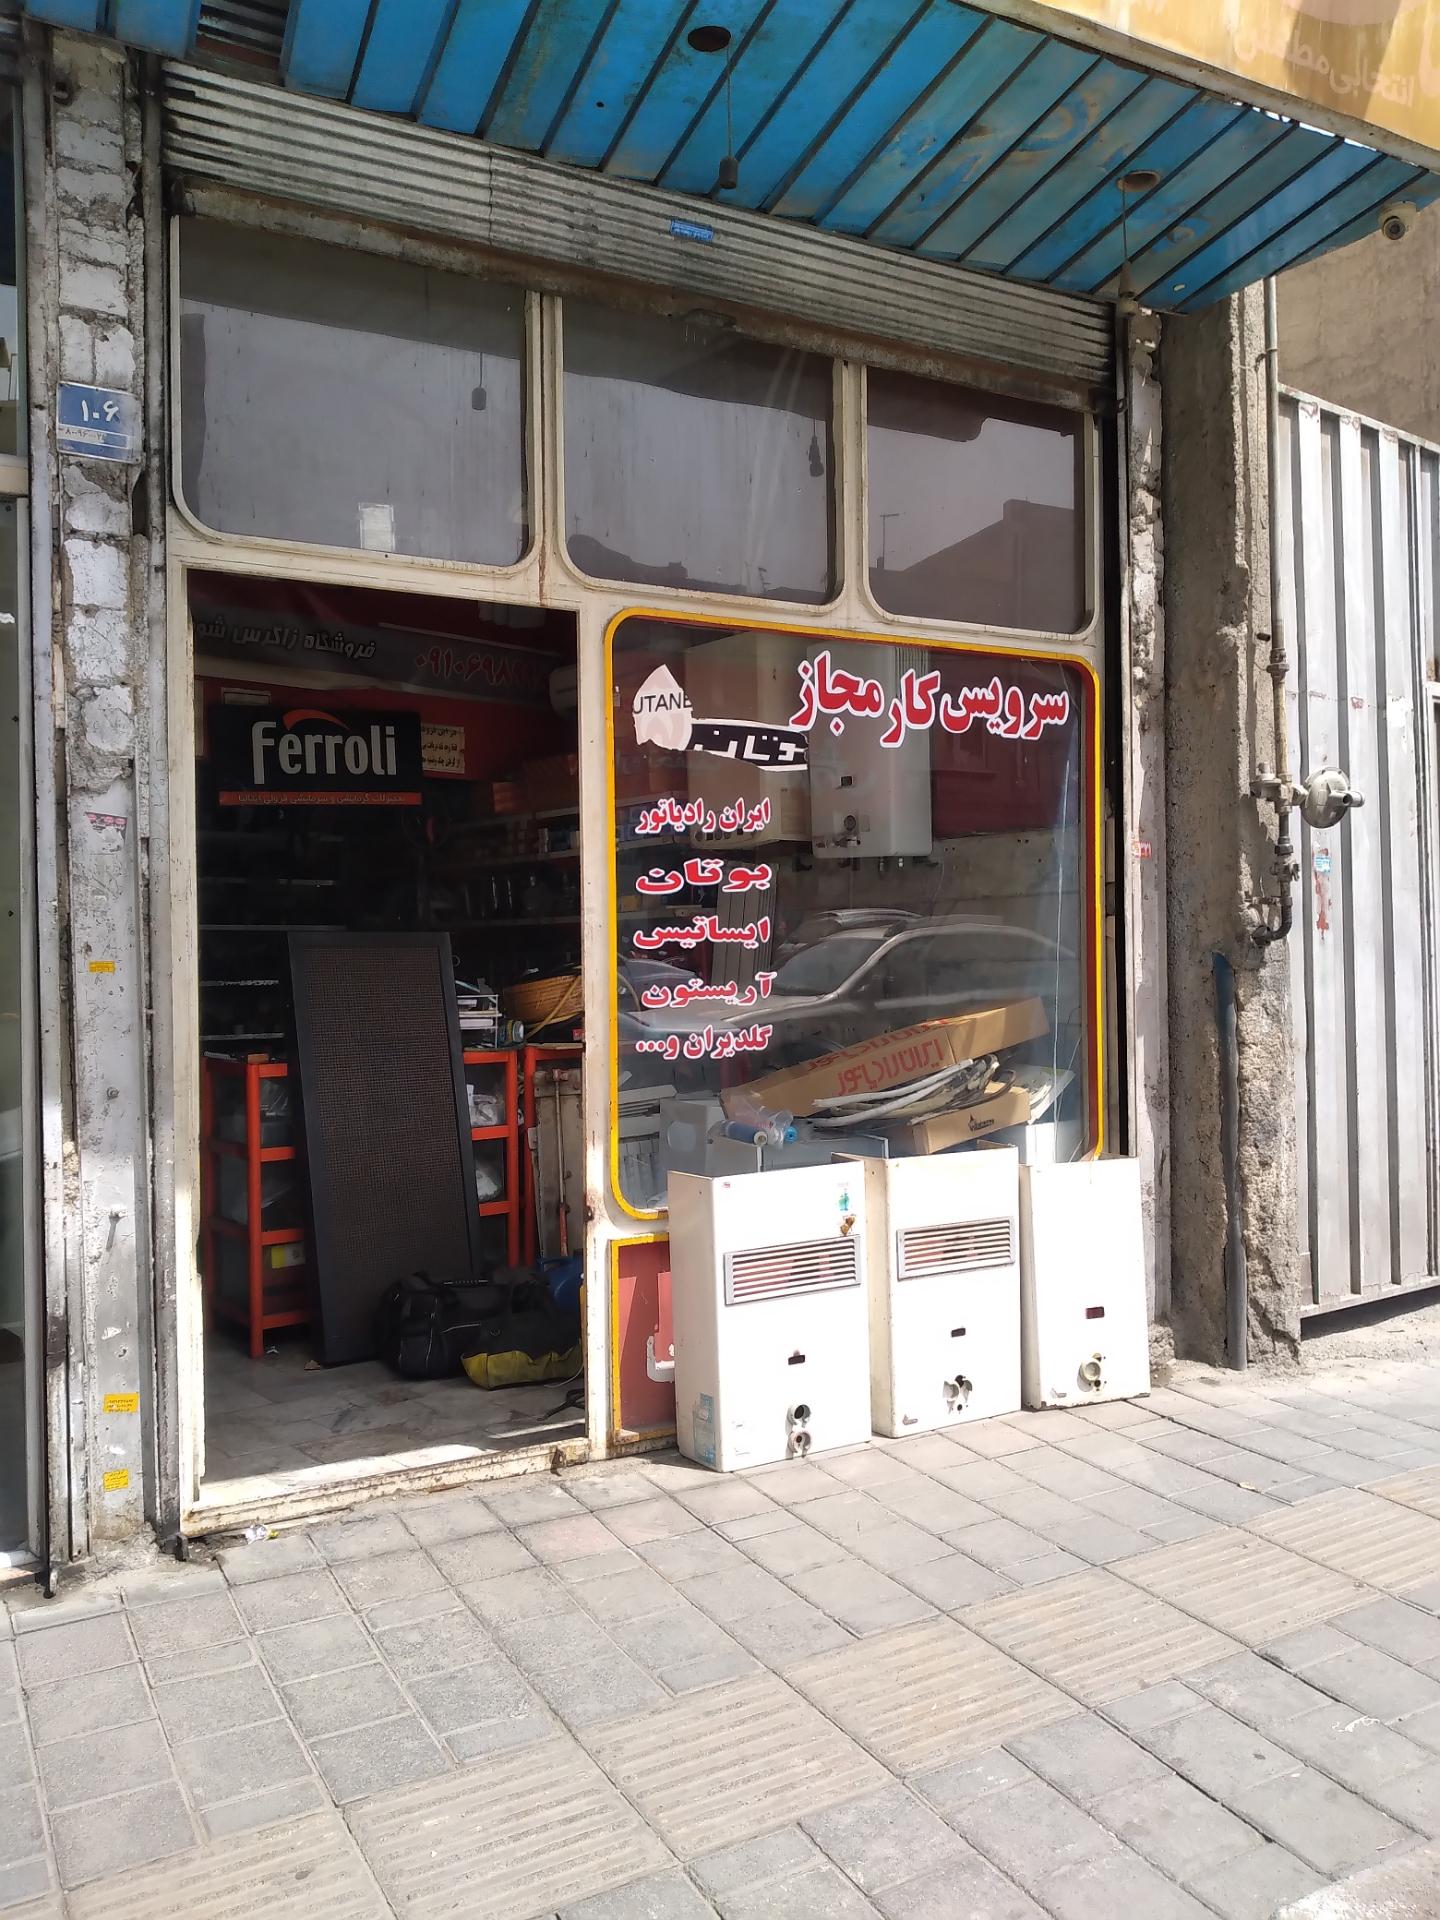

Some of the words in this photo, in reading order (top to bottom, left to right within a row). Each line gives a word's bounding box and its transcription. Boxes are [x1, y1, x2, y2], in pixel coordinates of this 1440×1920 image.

[81, 399, 120, 422] ۱۰۶
[303, 632, 377, 659] فروشگاه
[633, 691, 693, 715] UTANE
[790, 650, 883, 735] مجاز
[880, 669, 941, 747] کار
[940, 677, 1069, 739] سرویس
[251, 720, 397, 785] Ferroli
[635, 797, 718, 834] رادیاتور
[719, 797, 771, 832] ایران
[635, 858, 772, 894] بوتان
[633, 916, 770, 949] ایساتیس
[641, 970, 778, 1009] آریستون
[683, 1024, 774, 1060] گلدیران
[901, 1037, 945, 1073] ایران
[834, 1050, 902, 1097] رادیاتور
